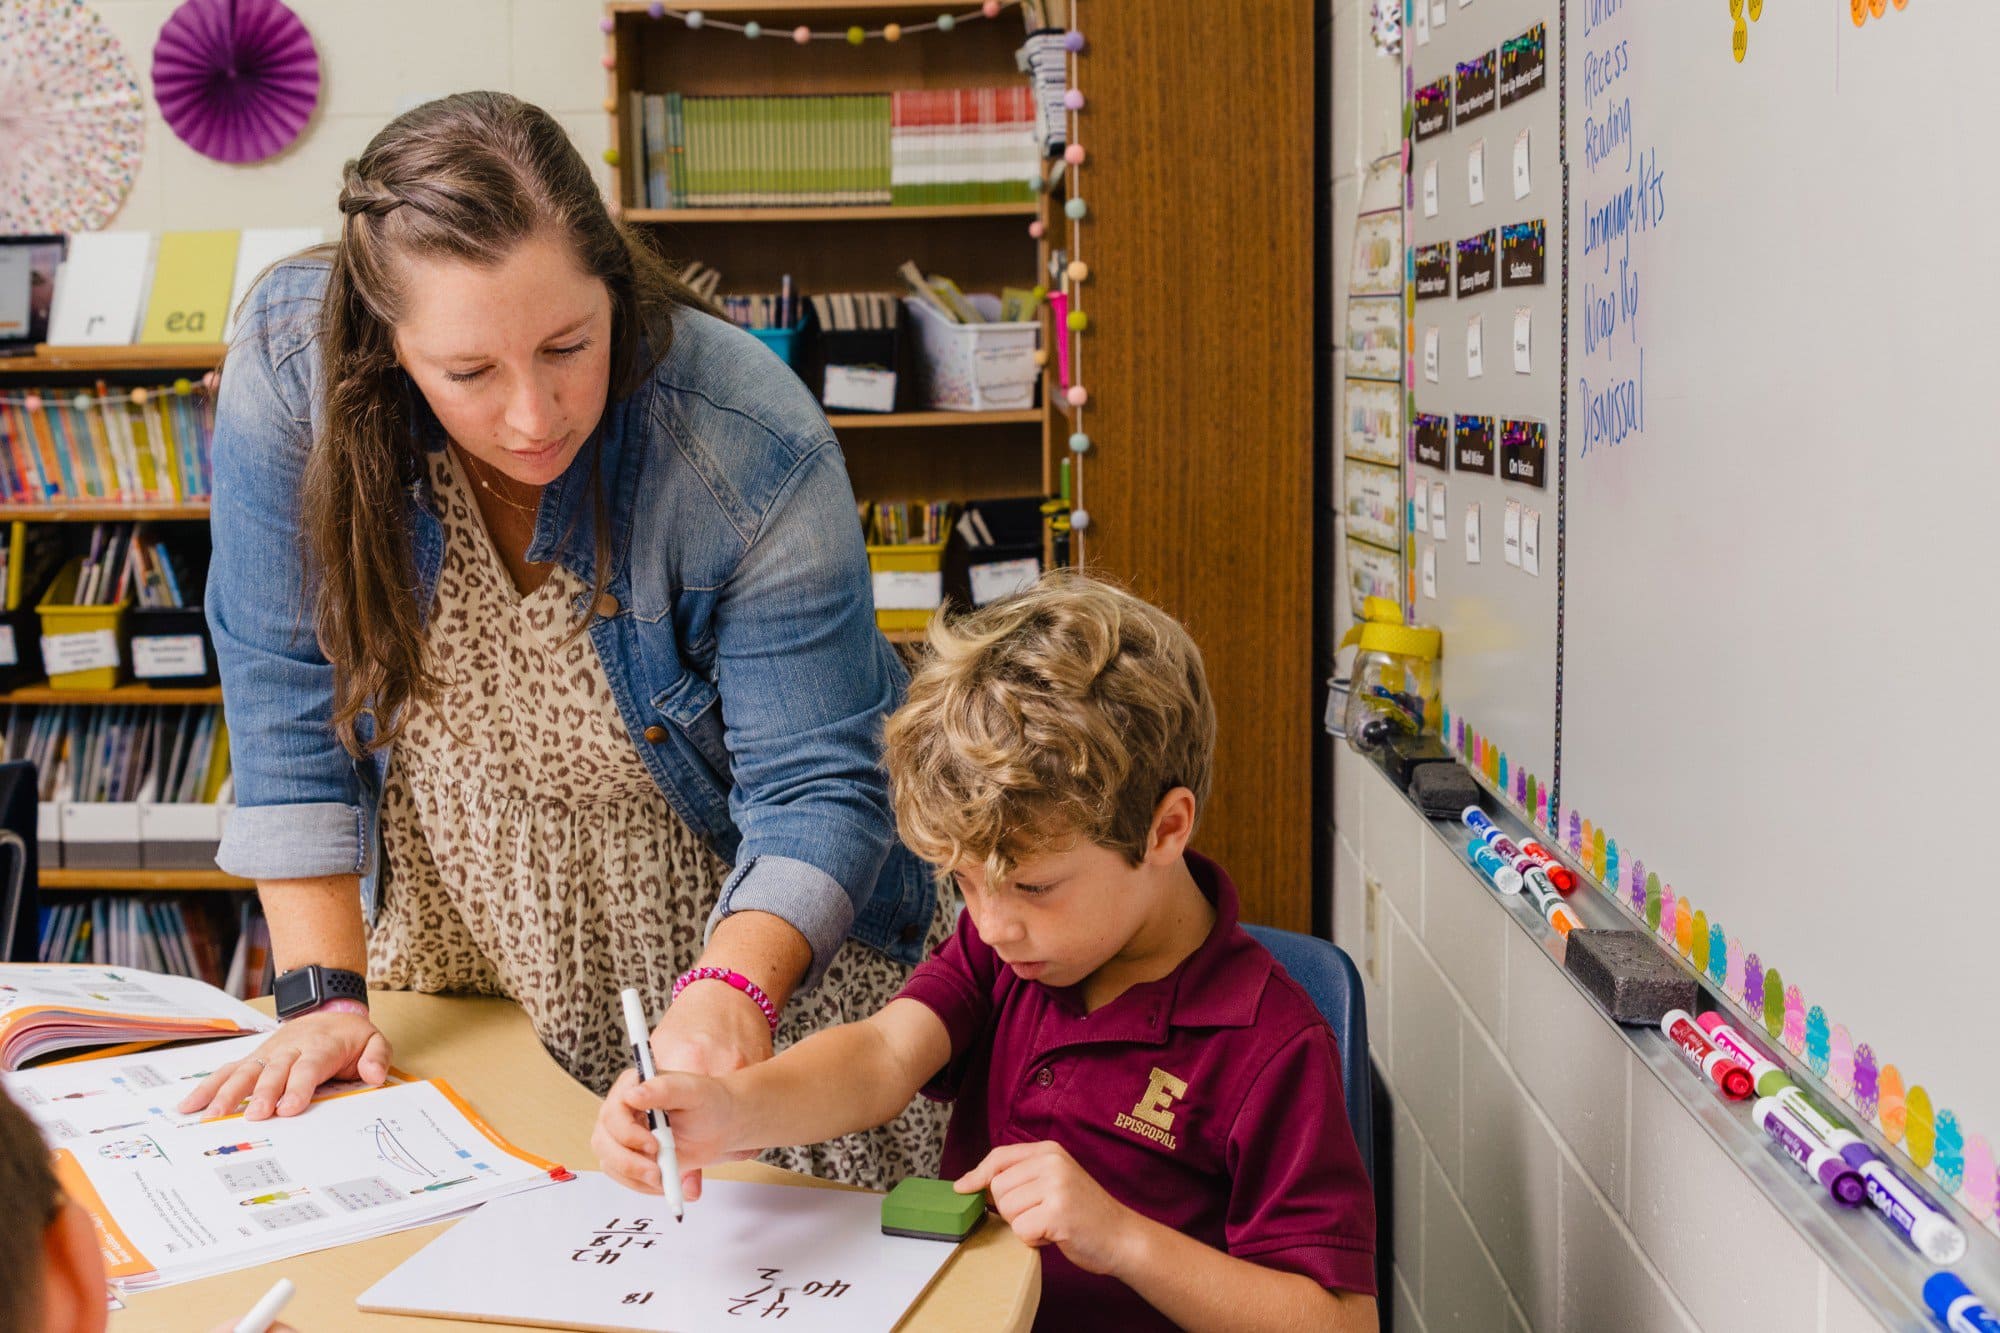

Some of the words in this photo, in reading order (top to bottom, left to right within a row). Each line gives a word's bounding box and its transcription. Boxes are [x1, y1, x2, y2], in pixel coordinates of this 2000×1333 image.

[1583, 0, 1623, 38] Lunc
[1583, 39, 1629, 111] Recess
[1584, 96, 1632, 174] Reading
[1584, 183, 1634, 275] Language
[1634, 146, 1665, 233] Arts
[164, 310, 206, 334] ea
[1584, 282, 1616, 362] Wrap
[1619, 256, 1639, 344] Up
[1578, 346, 1645, 460] Dismissal
[1508, 457, 1518, 475] On
[1131, 1066, 1189, 1132] E
[1113, 1111, 1177, 1151] EPISCOPAL
[571, 1248, 621, 1265] 42
[621, 1291, 655, 1305] 18
